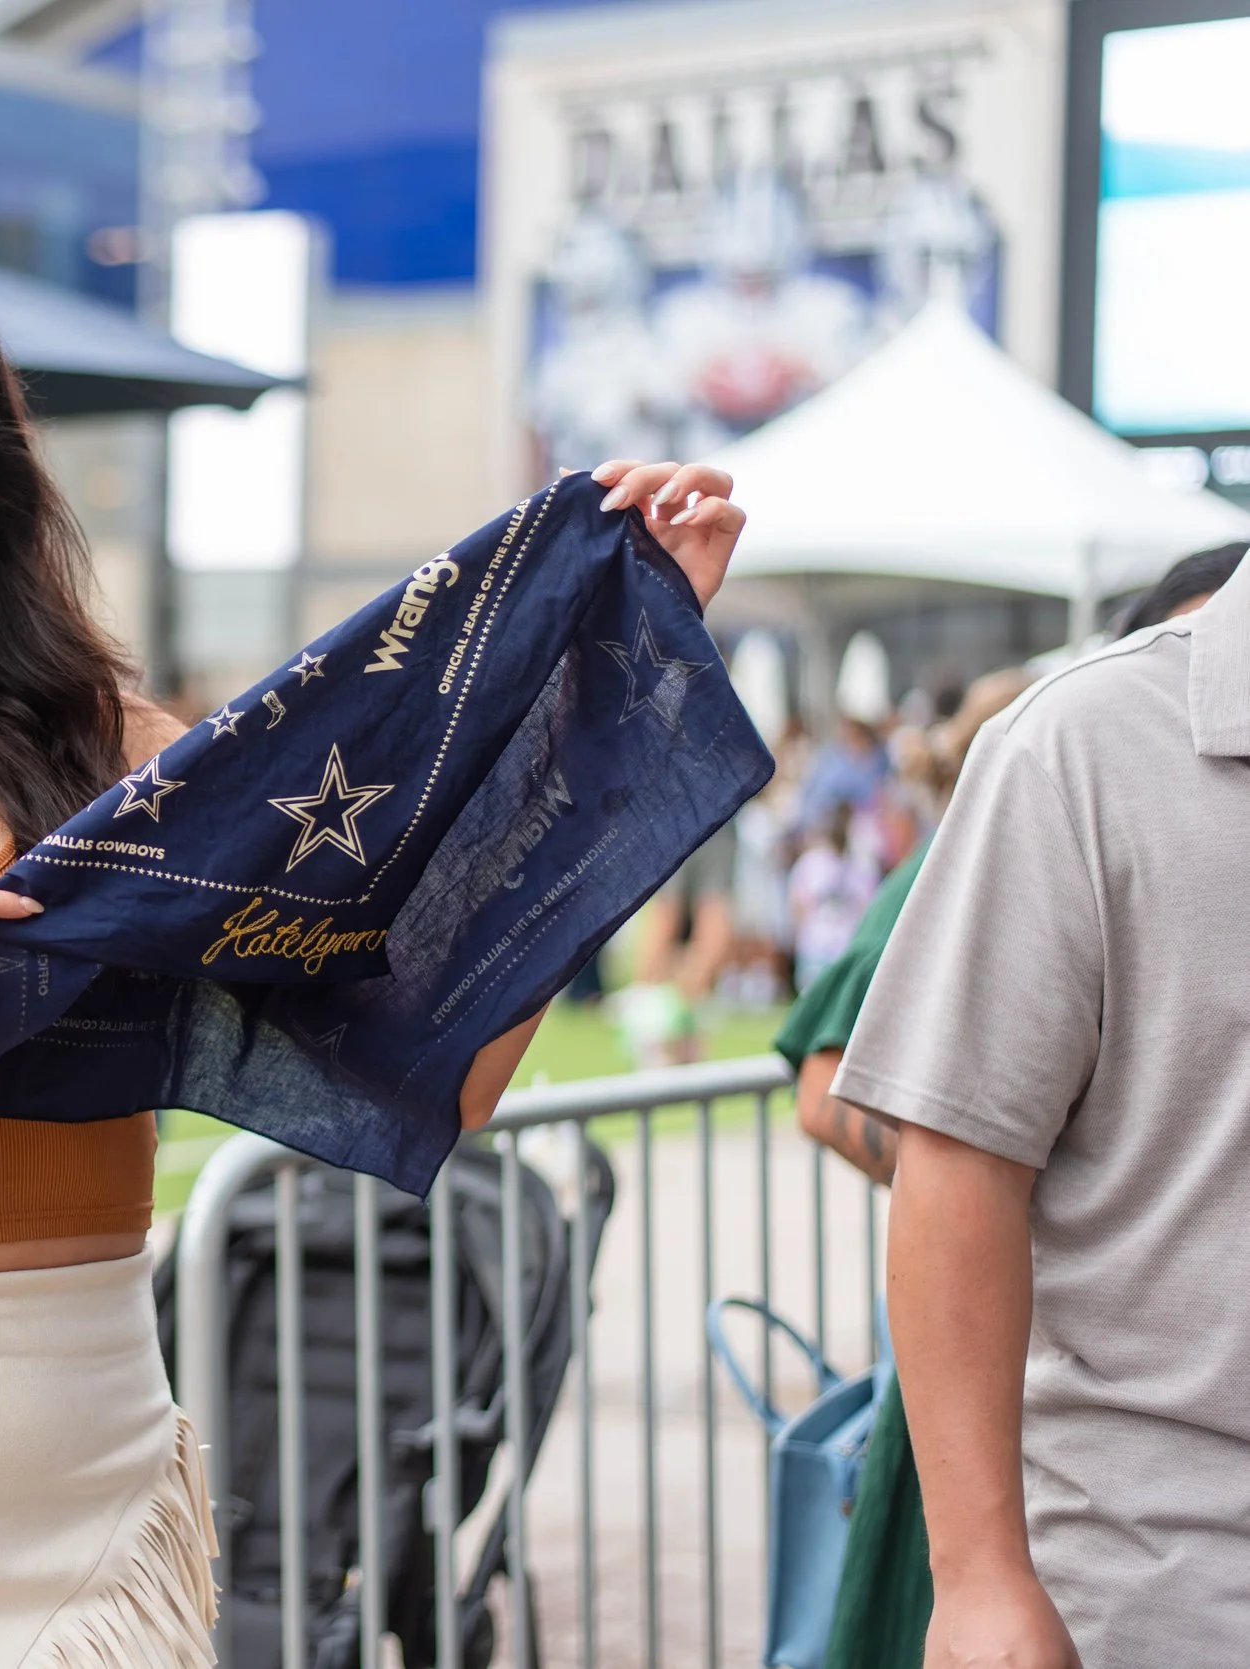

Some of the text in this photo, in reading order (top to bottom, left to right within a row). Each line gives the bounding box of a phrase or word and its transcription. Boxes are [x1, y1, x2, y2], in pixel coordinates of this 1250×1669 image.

[363, 552, 460, 673] Wrang
[438, 638, 469, 695] OFFICIAL
[462, 593, 487, 636] JEANS
[480, 571, 495, 591] OF
[489, 546, 508, 569] THE
[42, 834, 166, 860] DALLAS COWBOYS
